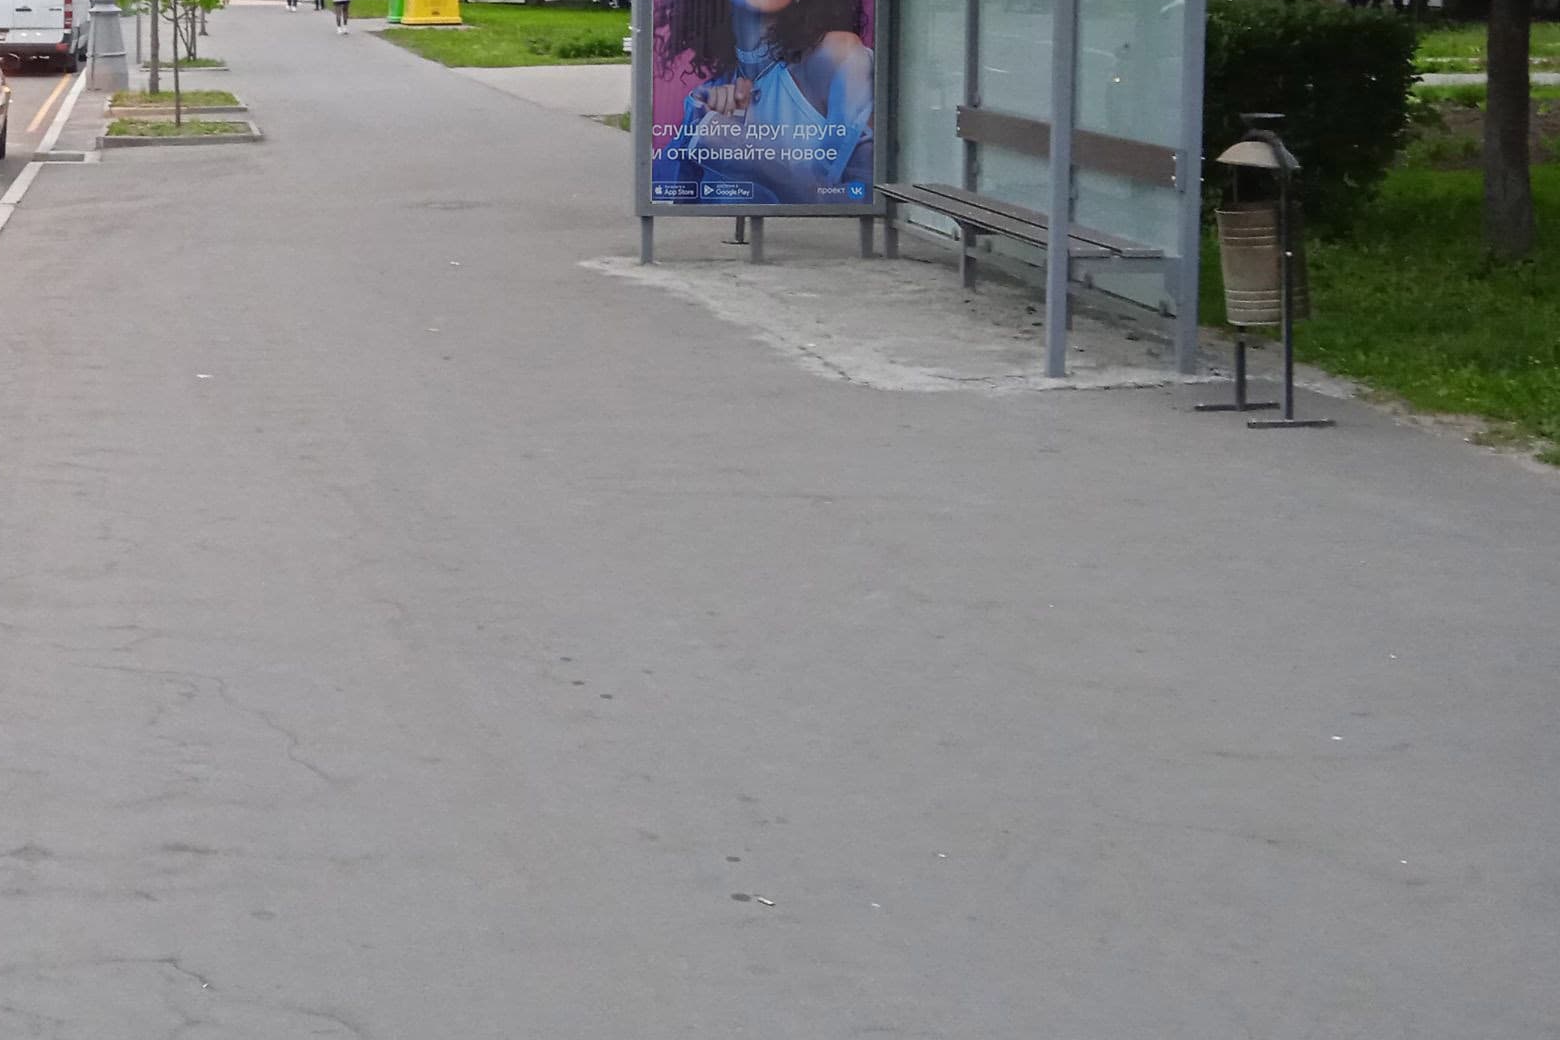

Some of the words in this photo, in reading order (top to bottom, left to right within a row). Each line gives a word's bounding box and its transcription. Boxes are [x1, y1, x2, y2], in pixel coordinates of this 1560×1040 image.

[652, 121, 741, 140] слушайте
[745, 124, 788, 140] друг
[792, 124, 847, 140] друга
[652, 148, 662, 160] и
[666, 144, 776, 163] открывайте
[781, 148, 838, 160] новое
[664, 188, 677, 196] App
[678, 188, 695, 196] Store
[715, 188, 737, 197] Google
[737, 188, 751, 197] Play
[817, 186, 846, 196] проект
